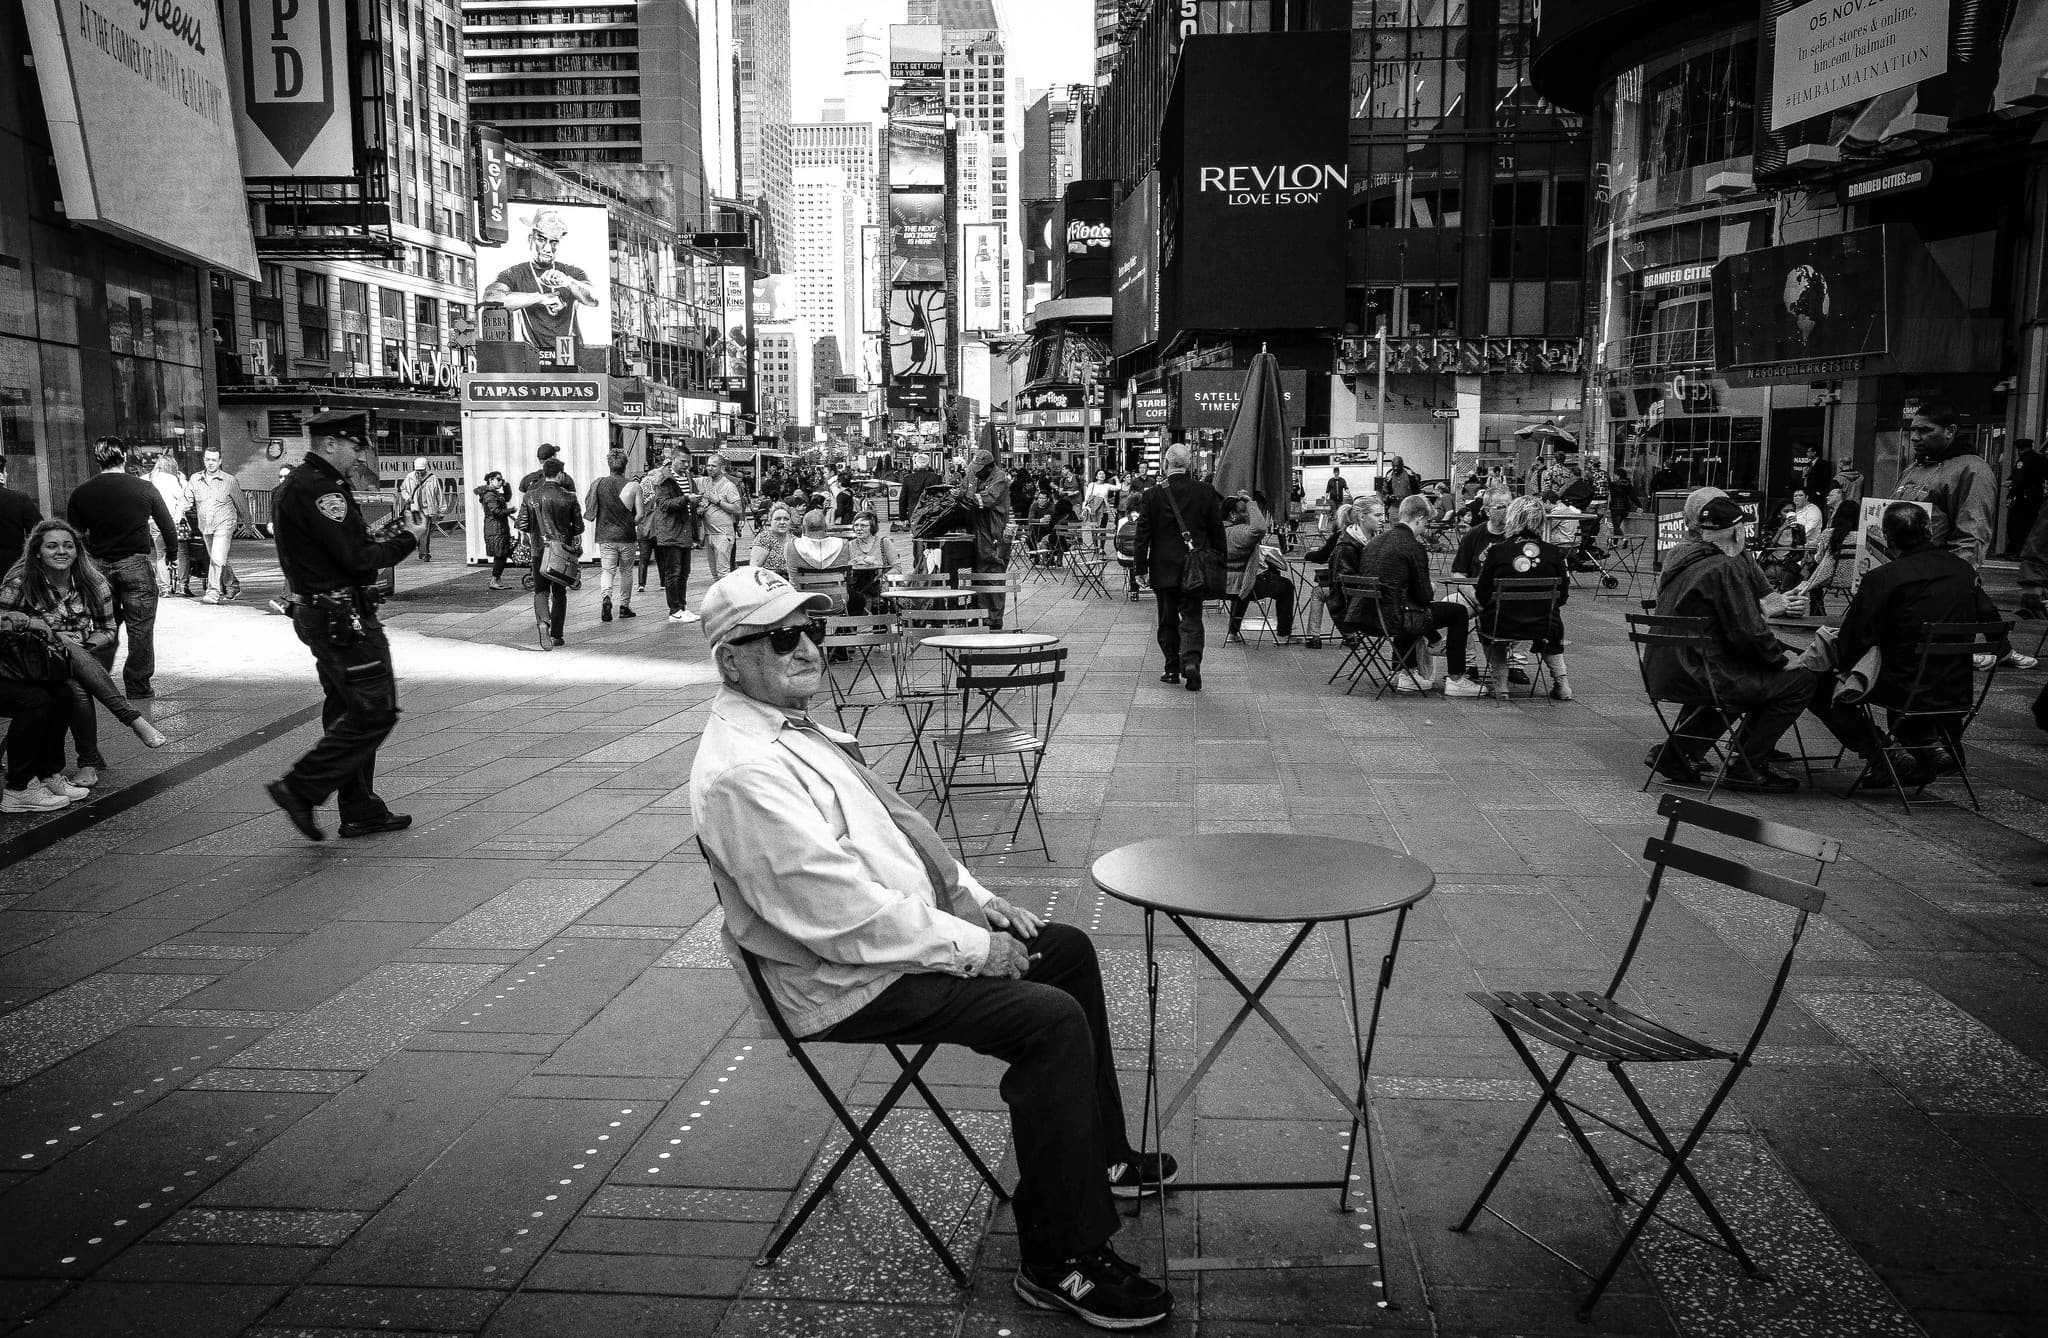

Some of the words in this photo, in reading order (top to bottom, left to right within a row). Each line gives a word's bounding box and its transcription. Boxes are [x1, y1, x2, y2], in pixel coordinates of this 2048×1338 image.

[80, 1, 92, 42] AT
[92, 9, 110, 55] THE
[111, 23, 142, 76] CORNER
[1798, 47, 1808, 61] In
[1810, 37, 1836, 57] select
[1838, 25, 1868, 45] stores
[1870, 19, 1878, 32] &
[1881, 6, 1918, 28] online,
[1813, 31, 1897, 74] hm.com/balmain
[1785, 46, 1930, 106] #HMBALMAINATION
[1200, 163, 1348, 192] REVLON
[1848, 178, 1881, 198] BRANDED
[1882, 171, 1922, 190] CITIES.com
[1228, 193, 1271, 206] LOVE
[1275, 193, 1291, 205] IS
[1643, 270, 1683, 288] BRANDED
[1683, 265, 1713, 281] CITIE
[727, 287, 742, 296] LION
[726, 297, 744, 307] KING
[483, 316, 507, 327] BUBBA
[485, 331, 506, 341] GUMP
[474, 386, 529, 397] TAPAS
[539, 386, 594, 397] PAPAS
[1194, 392, 1241, 401] SATELL
